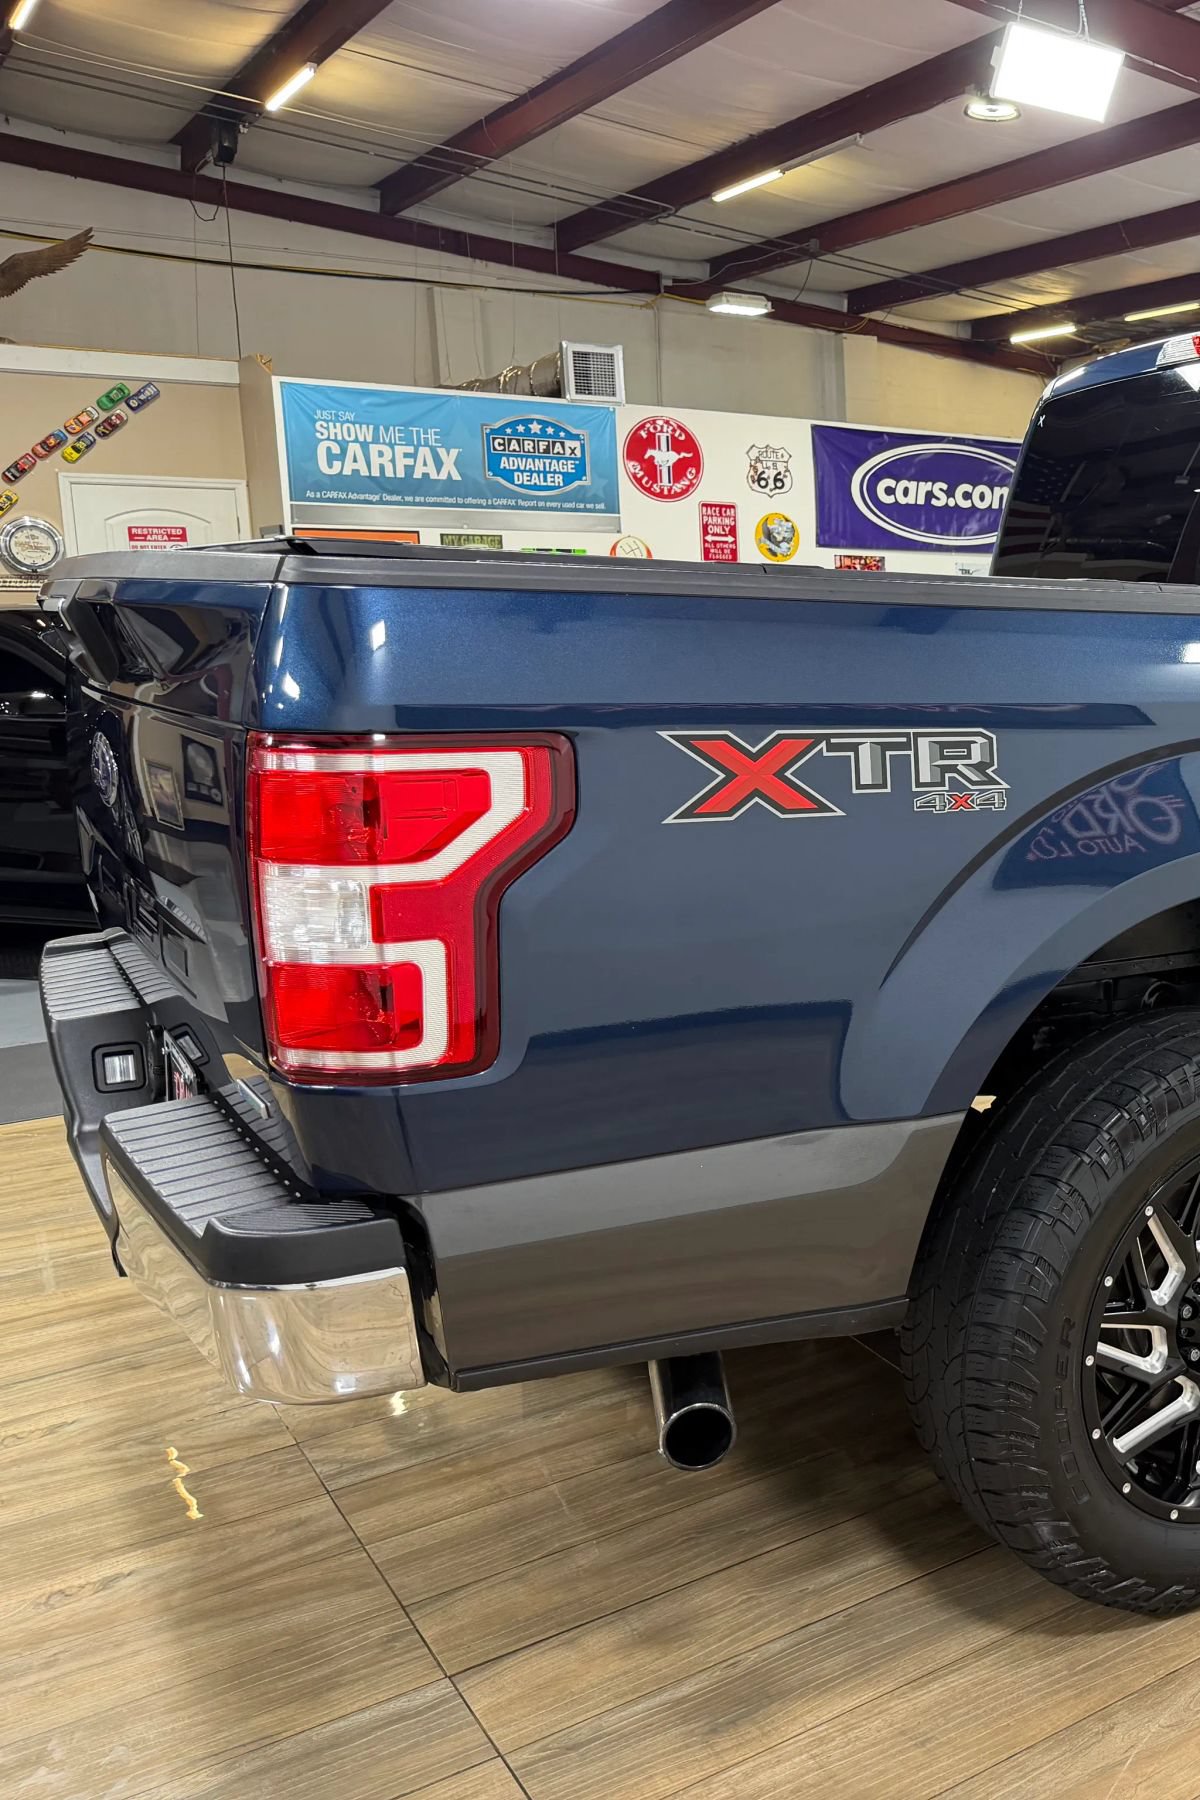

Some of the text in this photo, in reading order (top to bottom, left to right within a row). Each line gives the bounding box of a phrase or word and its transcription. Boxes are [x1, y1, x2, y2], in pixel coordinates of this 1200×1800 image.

[314, 410, 355, 421] JUST SAY
[315, 421, 442, 446] SHOW ME THE
[637, 422, 686, 440] FORD
[494, 438, 578, 457] CARFAX
[317, 441, 462, 481] CARFAX
[513, 472, 563, 487] DEALER
[627, 461, 697, 495] MUSTANG
[757, 470, 785, 490] 66
[306, 490, 315, 498] As
[702, 506, 735, 517] RACE CAR
[703, 516, 735, 526] PARKING
[131, 527, 183, 535] RESTRICTED
[707, 524, 731, 535] ONLY
[656, 728, 1011, 824] XTR
